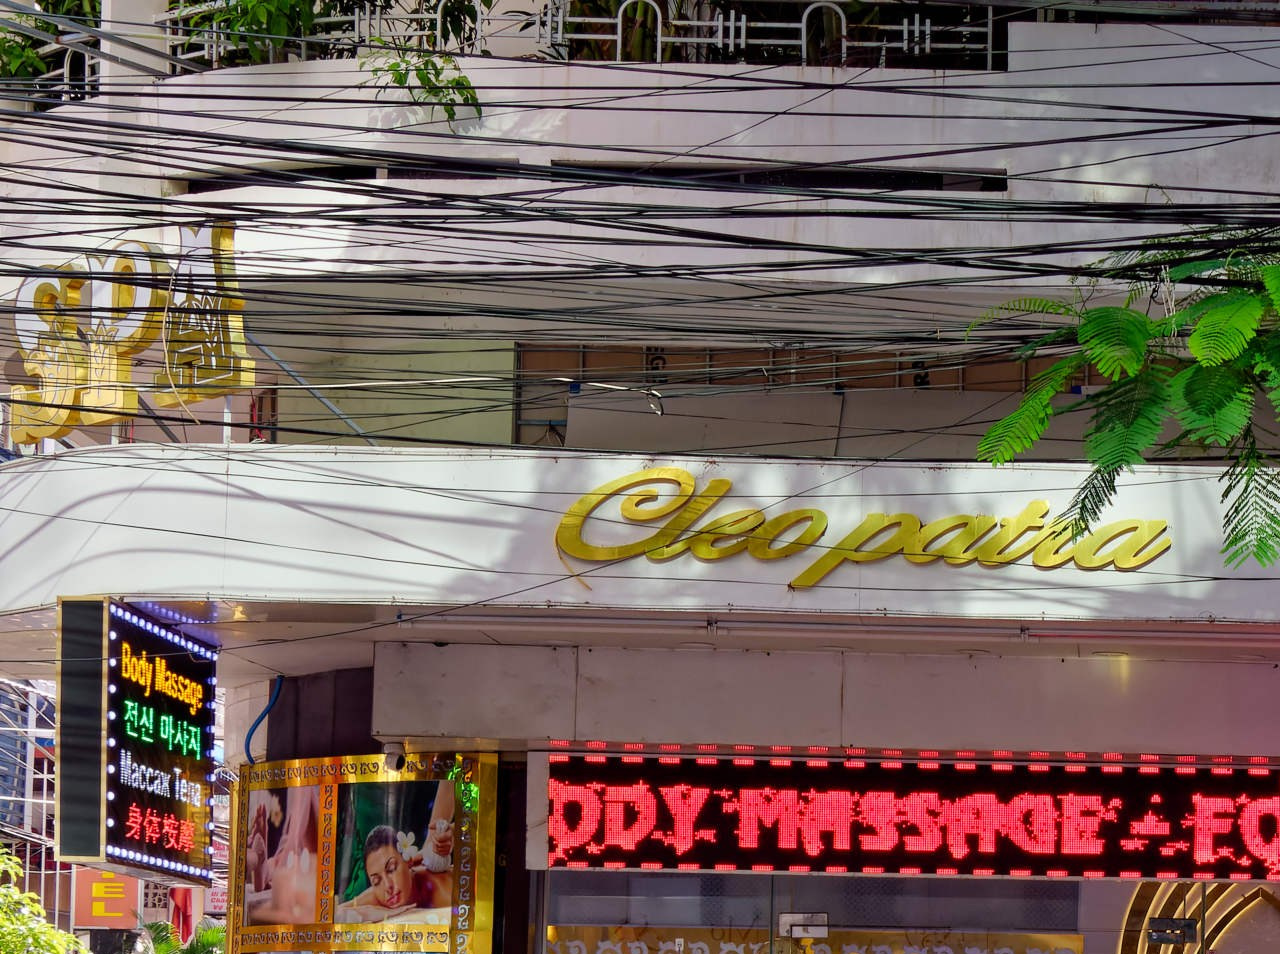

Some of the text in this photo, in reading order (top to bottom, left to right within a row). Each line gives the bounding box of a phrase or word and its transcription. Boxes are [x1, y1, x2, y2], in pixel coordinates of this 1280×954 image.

[555, 466, 1173, 590] Cleopatra
[121, 640, 204, 716] Body Massage
[123, 699, 201, 761] 전신 마사지
[119, 749, 172, 799] Массаж
[738, 785, 1104, 862] MASSAGE
